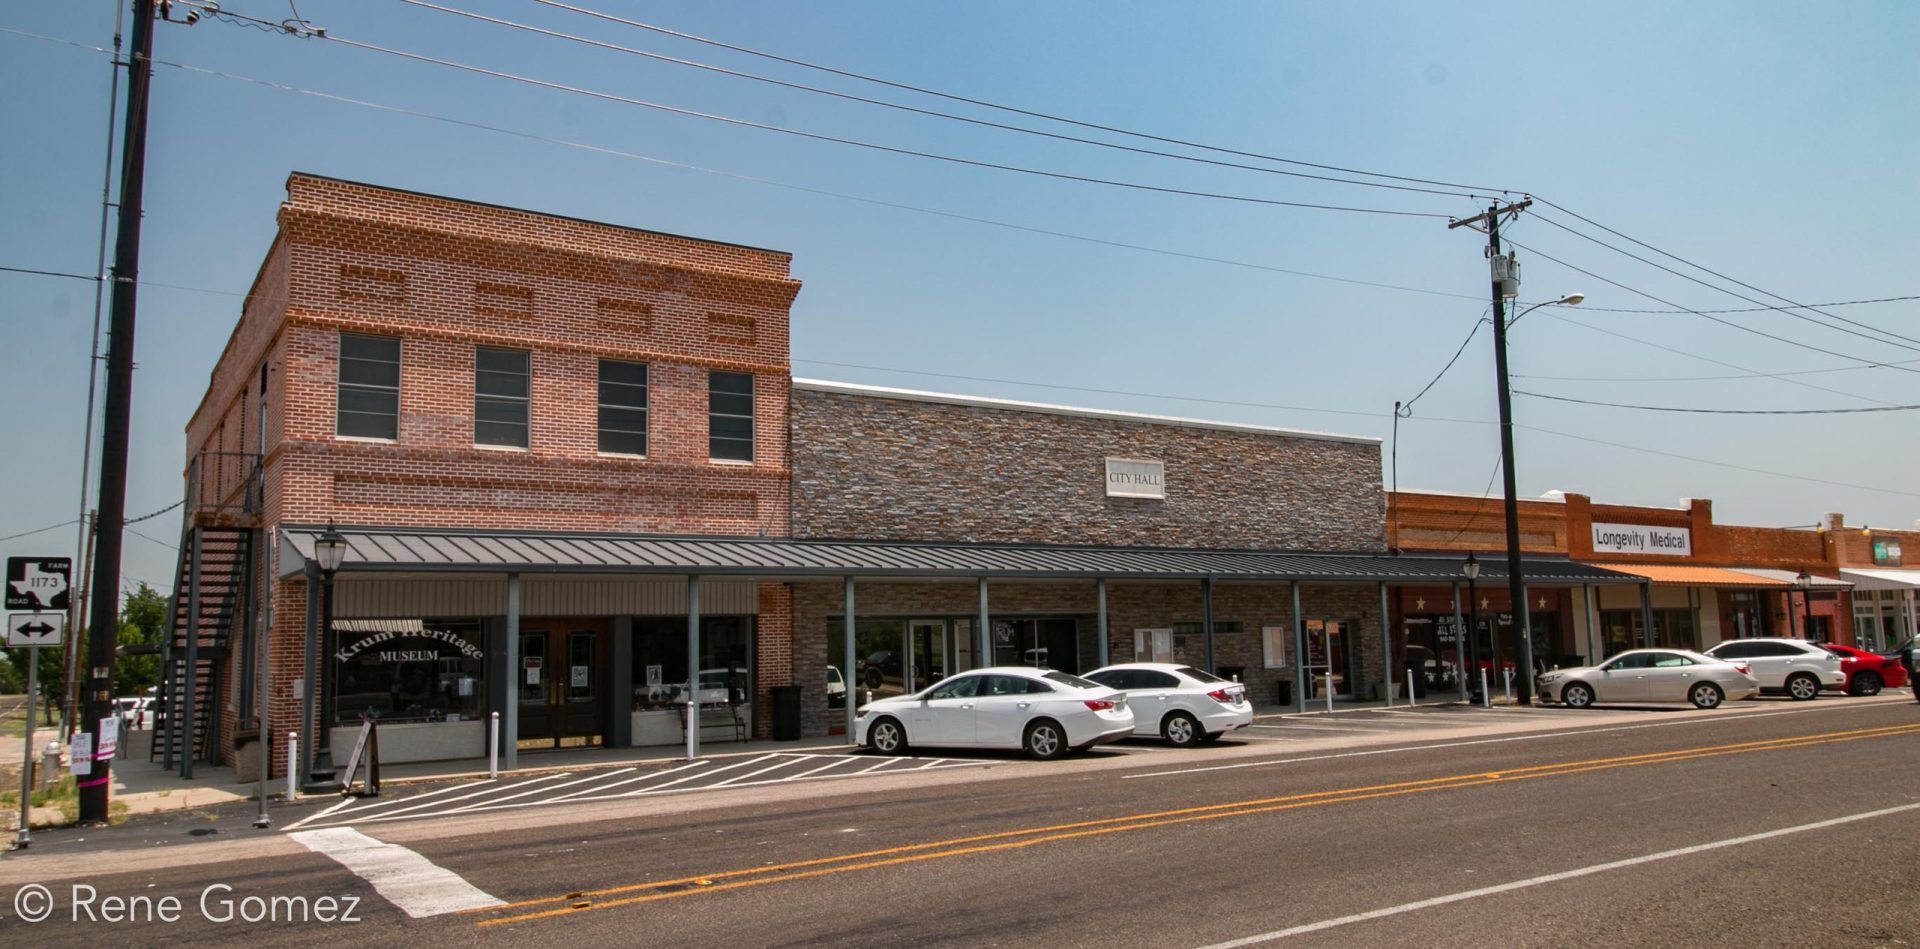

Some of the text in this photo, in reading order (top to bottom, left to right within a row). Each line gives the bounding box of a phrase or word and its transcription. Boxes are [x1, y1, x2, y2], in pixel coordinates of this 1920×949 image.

[1110, 472, 1160, 485] CITY HALL
[1596, 528, 1686, 550] Longevity Medical
[31, 577, 58, 587] 1173
[334, 630, 396, 663] Krum
[380, 650, 438, 662] MUSEUM
